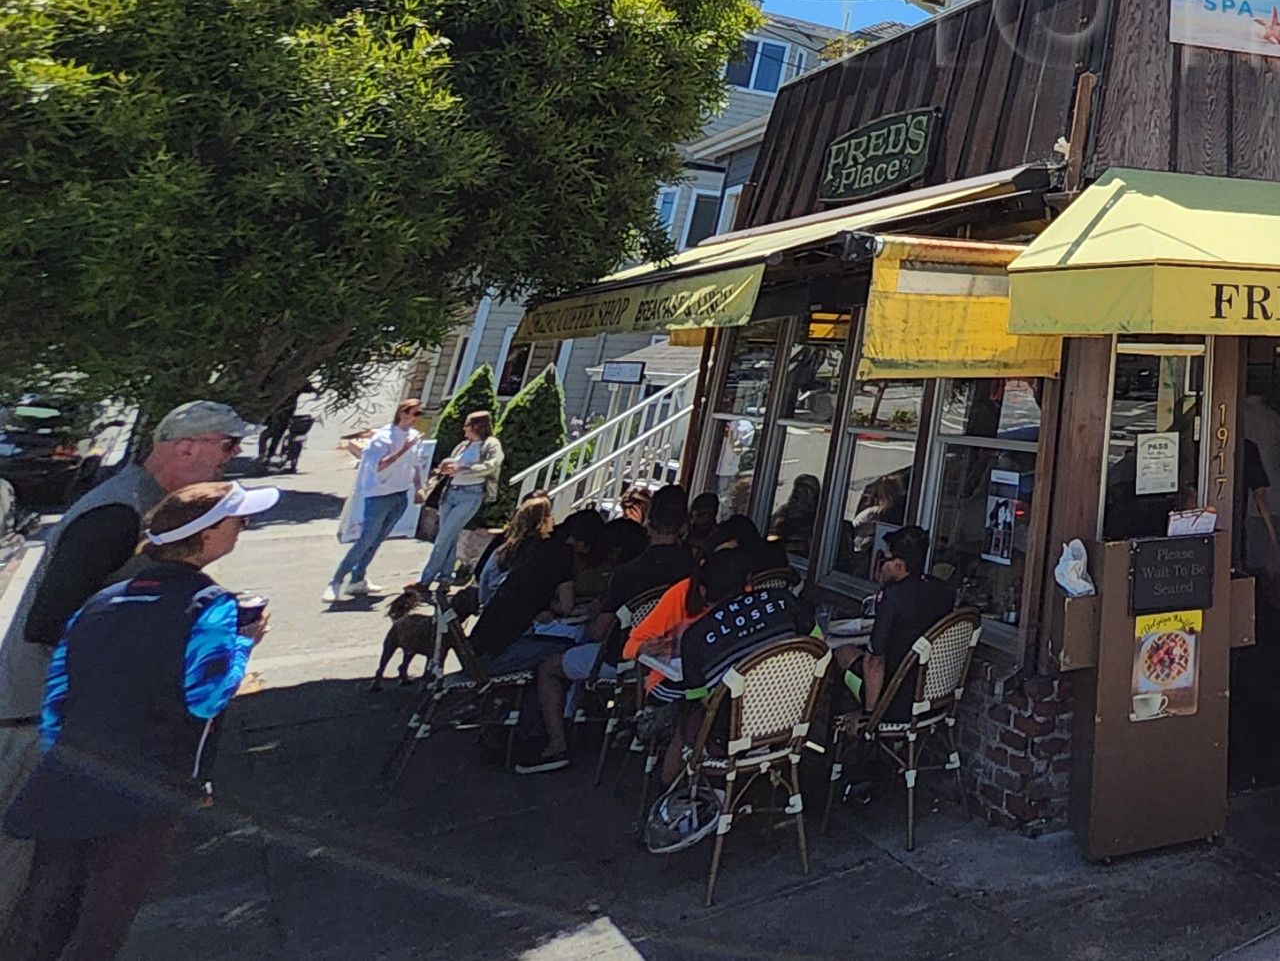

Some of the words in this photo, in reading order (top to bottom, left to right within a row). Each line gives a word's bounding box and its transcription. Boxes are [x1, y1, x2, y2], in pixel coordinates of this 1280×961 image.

[823, 115, 928, 185] FRED'S
[837, 159, 900, 194] Place
[599, 297, 631, 328] SHOP
[1147, 442, 1169, 451] PASS
[1217, 403, 1229, 501] 1917
[1156, 548, 1194, 561] Please
[1142, 565, 1170, 579] Wait
[1173, 563, 1188, 577] To
[1191, 562, 1206, 576] Be
[1153, 580, 1193, 596] Seated
[706, 600, 785, 643] CLOSET
